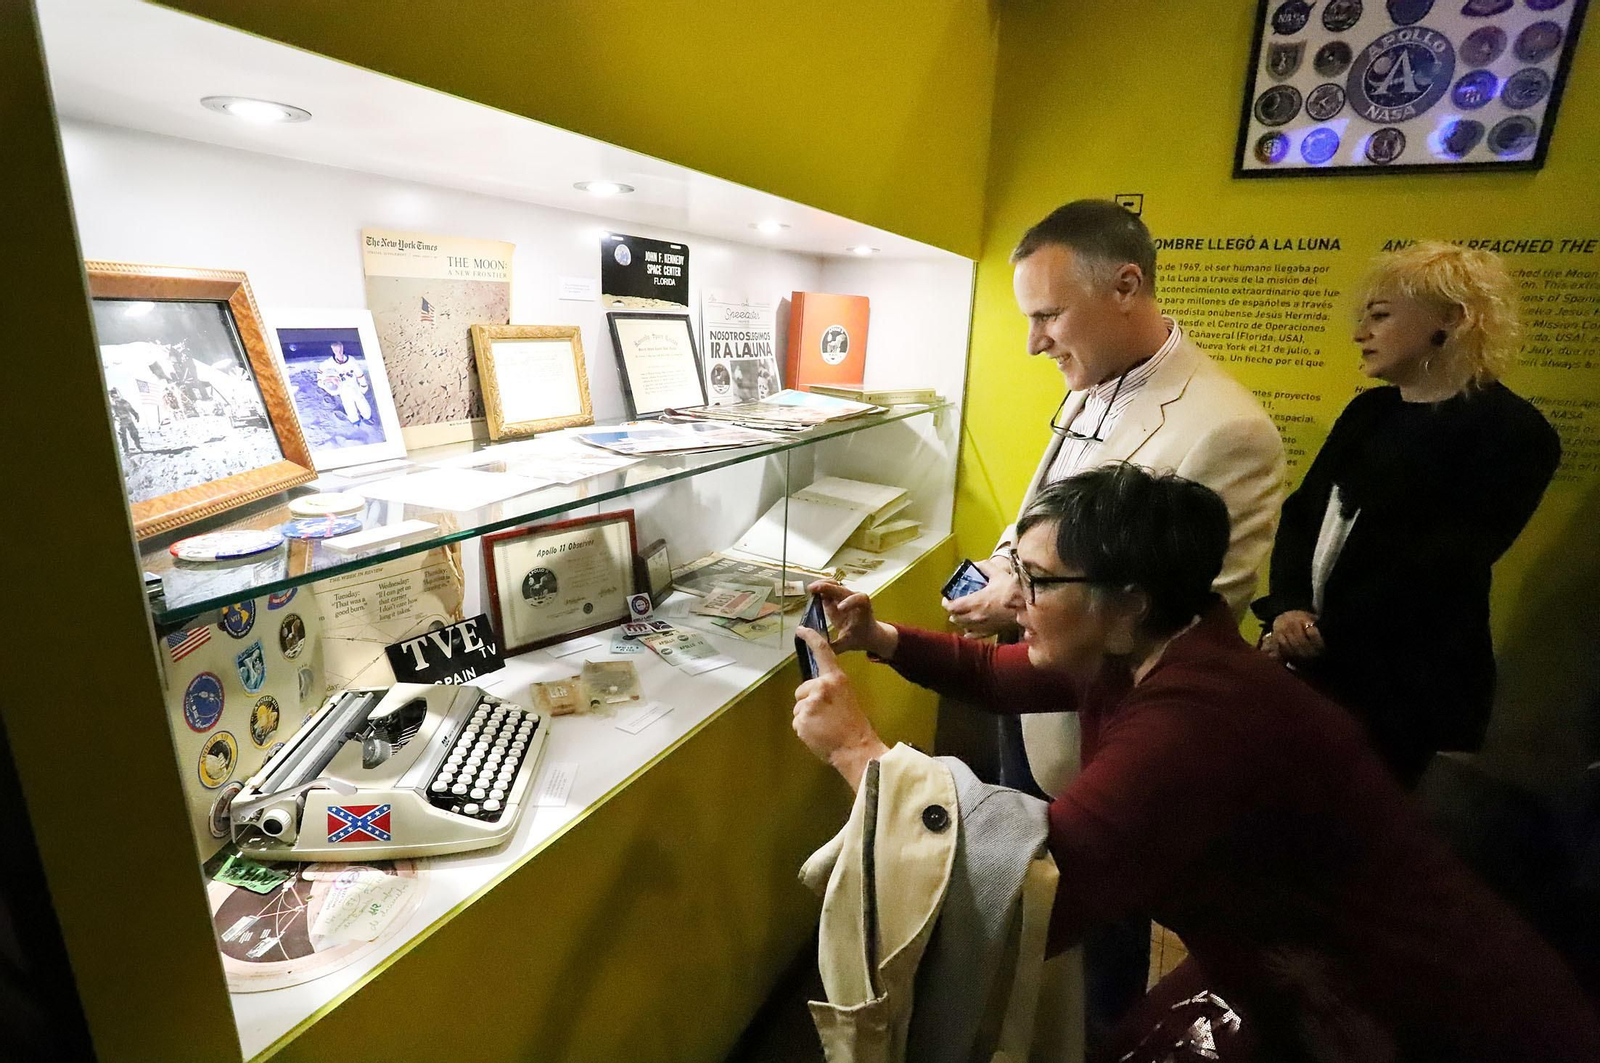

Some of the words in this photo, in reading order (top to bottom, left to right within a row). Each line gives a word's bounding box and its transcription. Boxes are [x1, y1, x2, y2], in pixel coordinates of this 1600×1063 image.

[1368, 29, 1446, 58] APOLLO
[1365, 105, 1416, 120] NASA
[366, 236, 380, 247] The
[380, 238, 396, 247] New
[398, 240, 416, 252] York
[416, 240, 438, 252] Times
[1154, 238, 1204, 250] OMBRE
[1208, 236, 1256, 250] LLEGÓ
[1259, 238, 1270, 250] A
[1274, 238, 1293, 250] LA
[1298, 238, 1341, 250] LUNA
[1468, 240, 1554, 253] REACHED
[1560, 240, 1599, 253] THE
[446, 256, 470, 268] THE
[473, 258, 508, 270] MOON:
[645, 251, 658, 262] JOHN
[664, 253, 684, 266] KENNEDY
[473, 270, 508, 278] FRONTIER
[647, 264, 662, 275] SPACE
[664, 265, 682, 276] CENTER
[1234, 264, 1272, 272] humano
[1274, 264, 1310, 274] llegaba
[1312, 266, 1330, 274] por
[654, 277, 676, 286] FLORIDA
[1161, 286, 1230, 294] acontecimiento
[1232, 288, 1300, 296] extraordinario
[1302, 290, 1320, 298] que
[1165, 298, 1184, 306] para
[1243, 299, 1291, 308] españoles
[1162, 308, 1205, 316] periodista
[1208, 310, 1252, 318] onubense
[1178, 319, 1204, 327] desde
[1218, 320, 1248, 329] Centro
[1252, 322, 1262, 330] de
[1266, 322, 1326, 332] Operaciones
[710, 330, 750, 340] NOSOTROS
[711, 342, 721, 358] IR
[723, 342, 734, 358] A
[736, 342, 752, 358] LA
[750, 342, 773, 358] UNA
[1196, 342, 1223, 350] Nueva
[1226, 342, 1246, 351] York
[1248, 344, 1257, 352] el
[1260, 344, 1270, 352] 21
[1274, 345, 1285, 354] de
[1230, 354, 1242, 362] Un
[1245, 355, 1273, 364] hecho
[1276, 358, 1292, 366] por
[1294, 358, 1304, 366] el
[1306, 360, 1324, 368] que
[1274, 392, 1321, 401] proyectos
[537, 548, 558, 558] Apollo
[568, 540, 595, 550] Observer
[379, 578, 410, 590] Wednesday:
[334, 590, 360, 600] Tuesday:
[335, 608, 350, 618] good
[401, 619, 484, 672] TVE
[479, 643, 496, 658] TV
[680, 642, 696, 650] APOLLO
